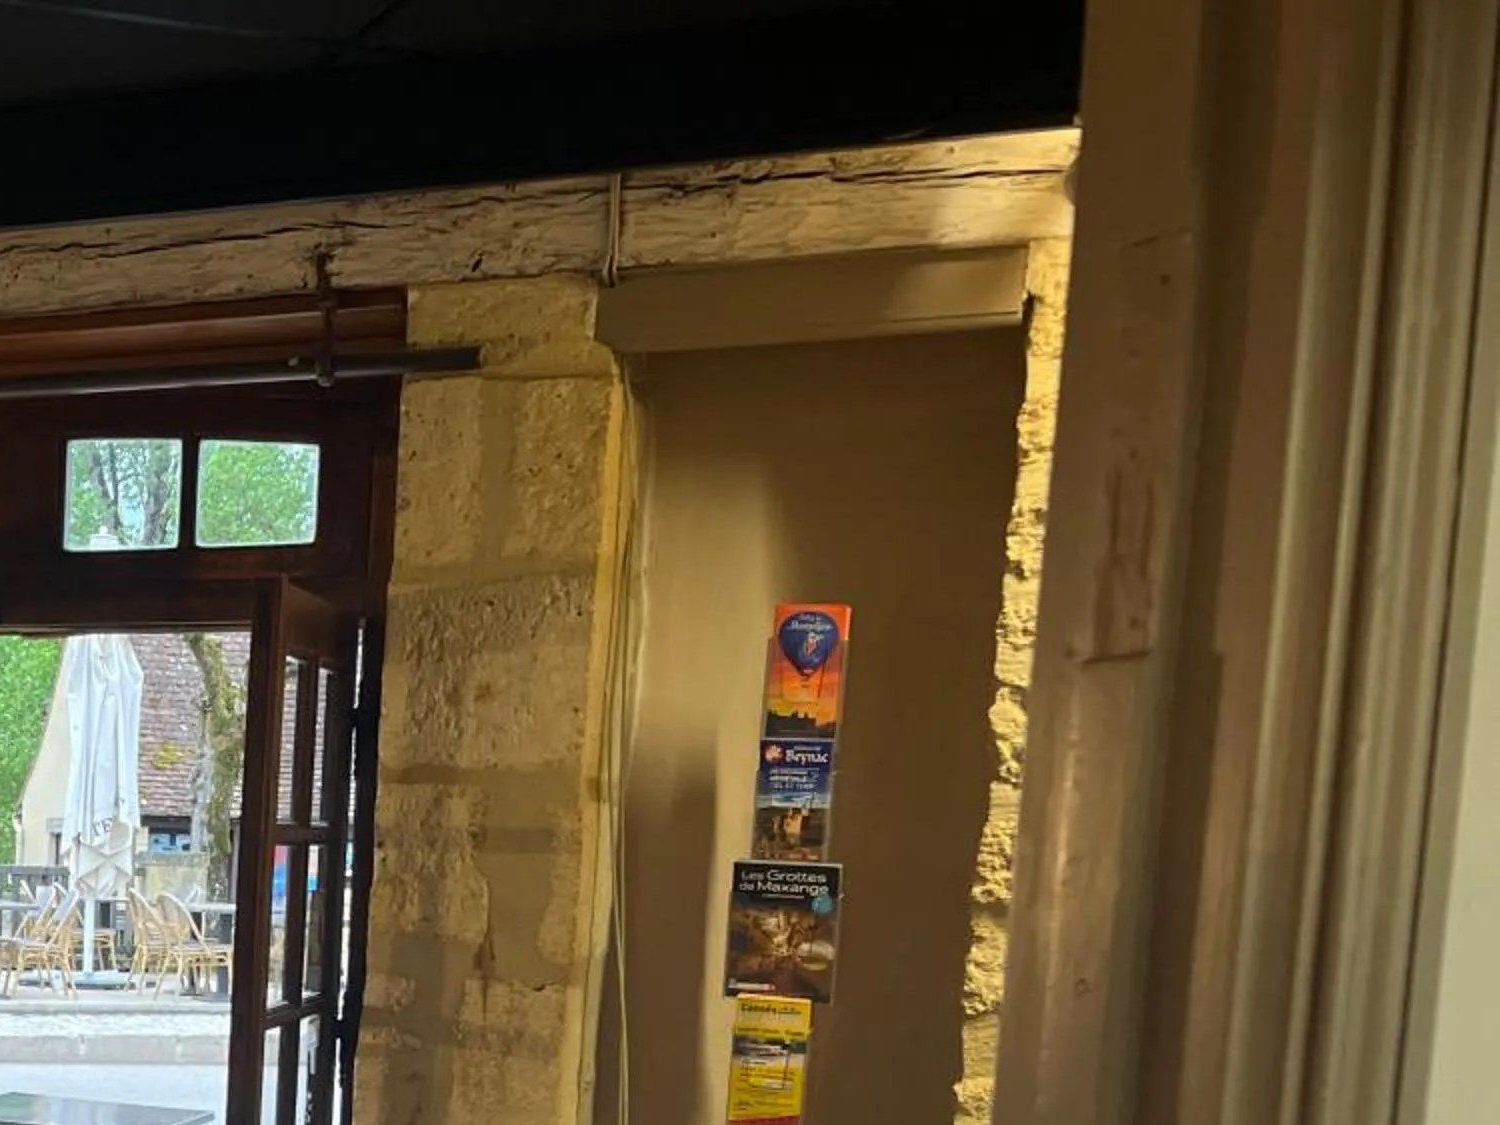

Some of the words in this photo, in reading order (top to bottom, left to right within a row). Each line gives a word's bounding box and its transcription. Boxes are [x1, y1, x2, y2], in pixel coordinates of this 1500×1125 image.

[785, 748, 829, 766] Beynac
[741, 870, 764, 881] Les
[766, 869, 827, 883] Grottes
[739, 881, 755, 891] de
[756, 881, 830, 897] Maxange
